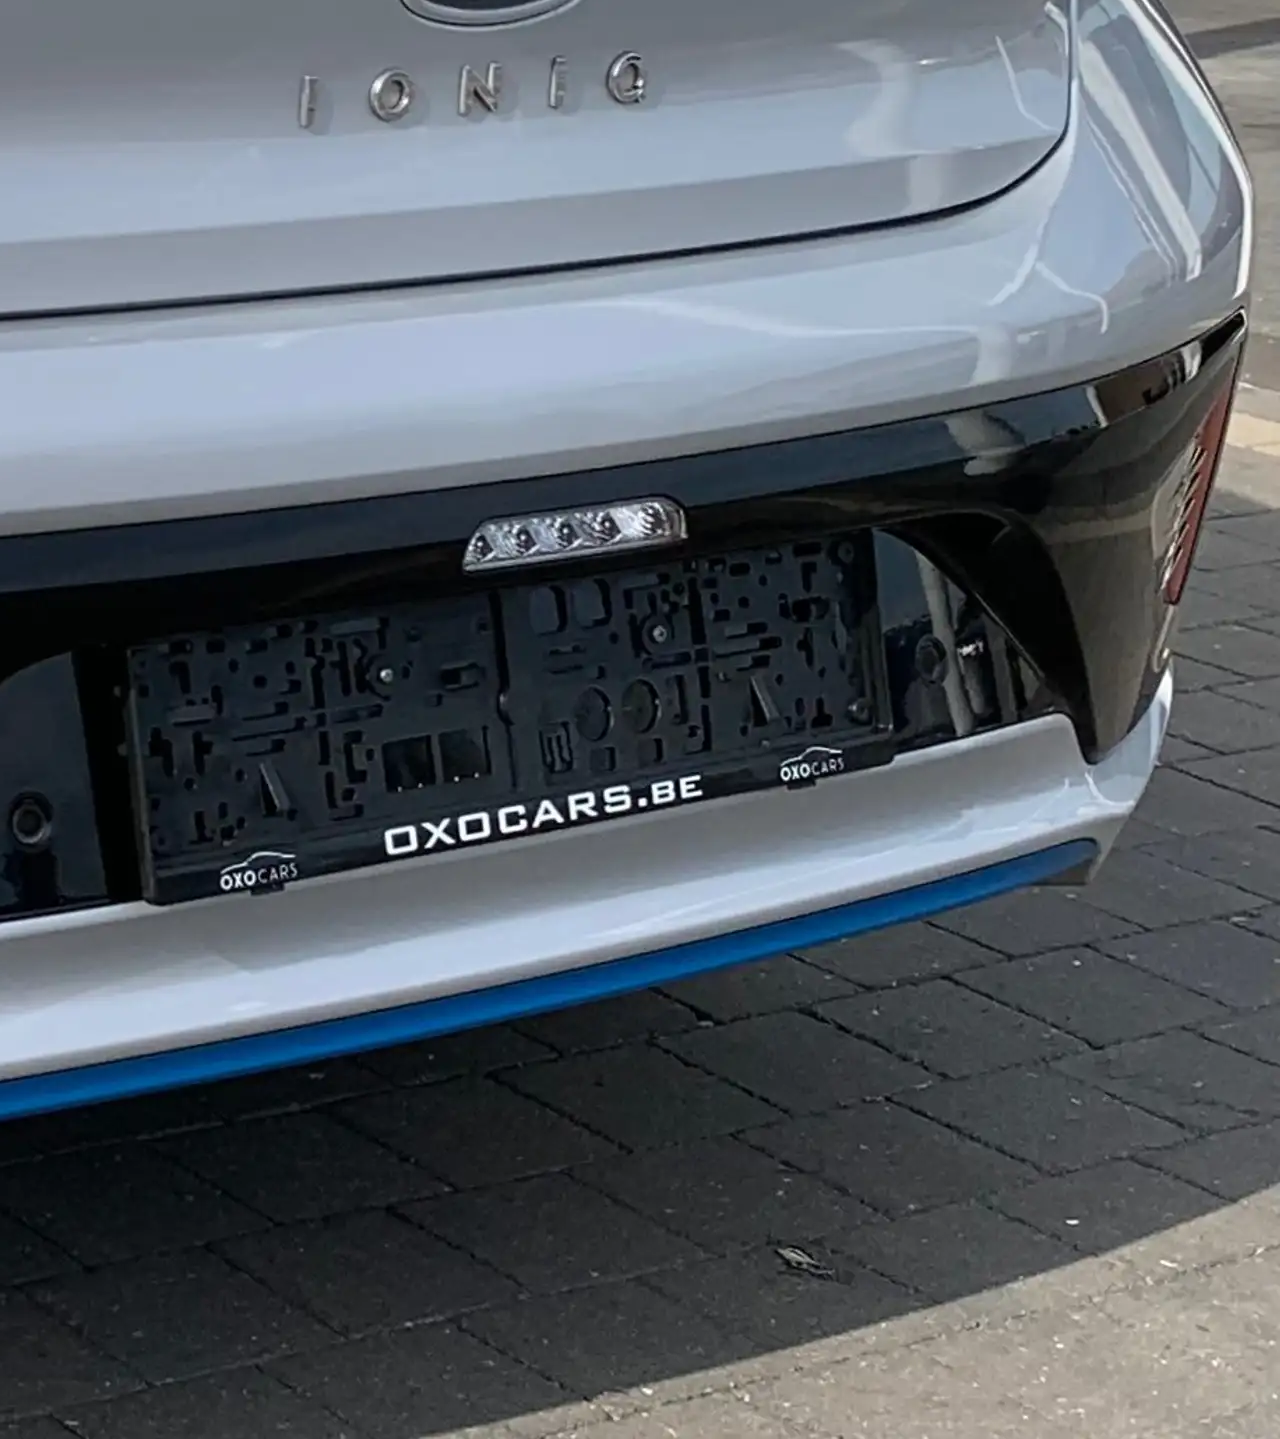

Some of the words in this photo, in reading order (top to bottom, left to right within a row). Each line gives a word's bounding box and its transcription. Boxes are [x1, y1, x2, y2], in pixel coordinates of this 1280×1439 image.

[299, 51, 644, 129] IONIQ
[780, 757, 844, 781] OXOCARS
[384, 775, 703, 856] OXOCARS.BE
[220, 863, 298, 891] OXOCARS
